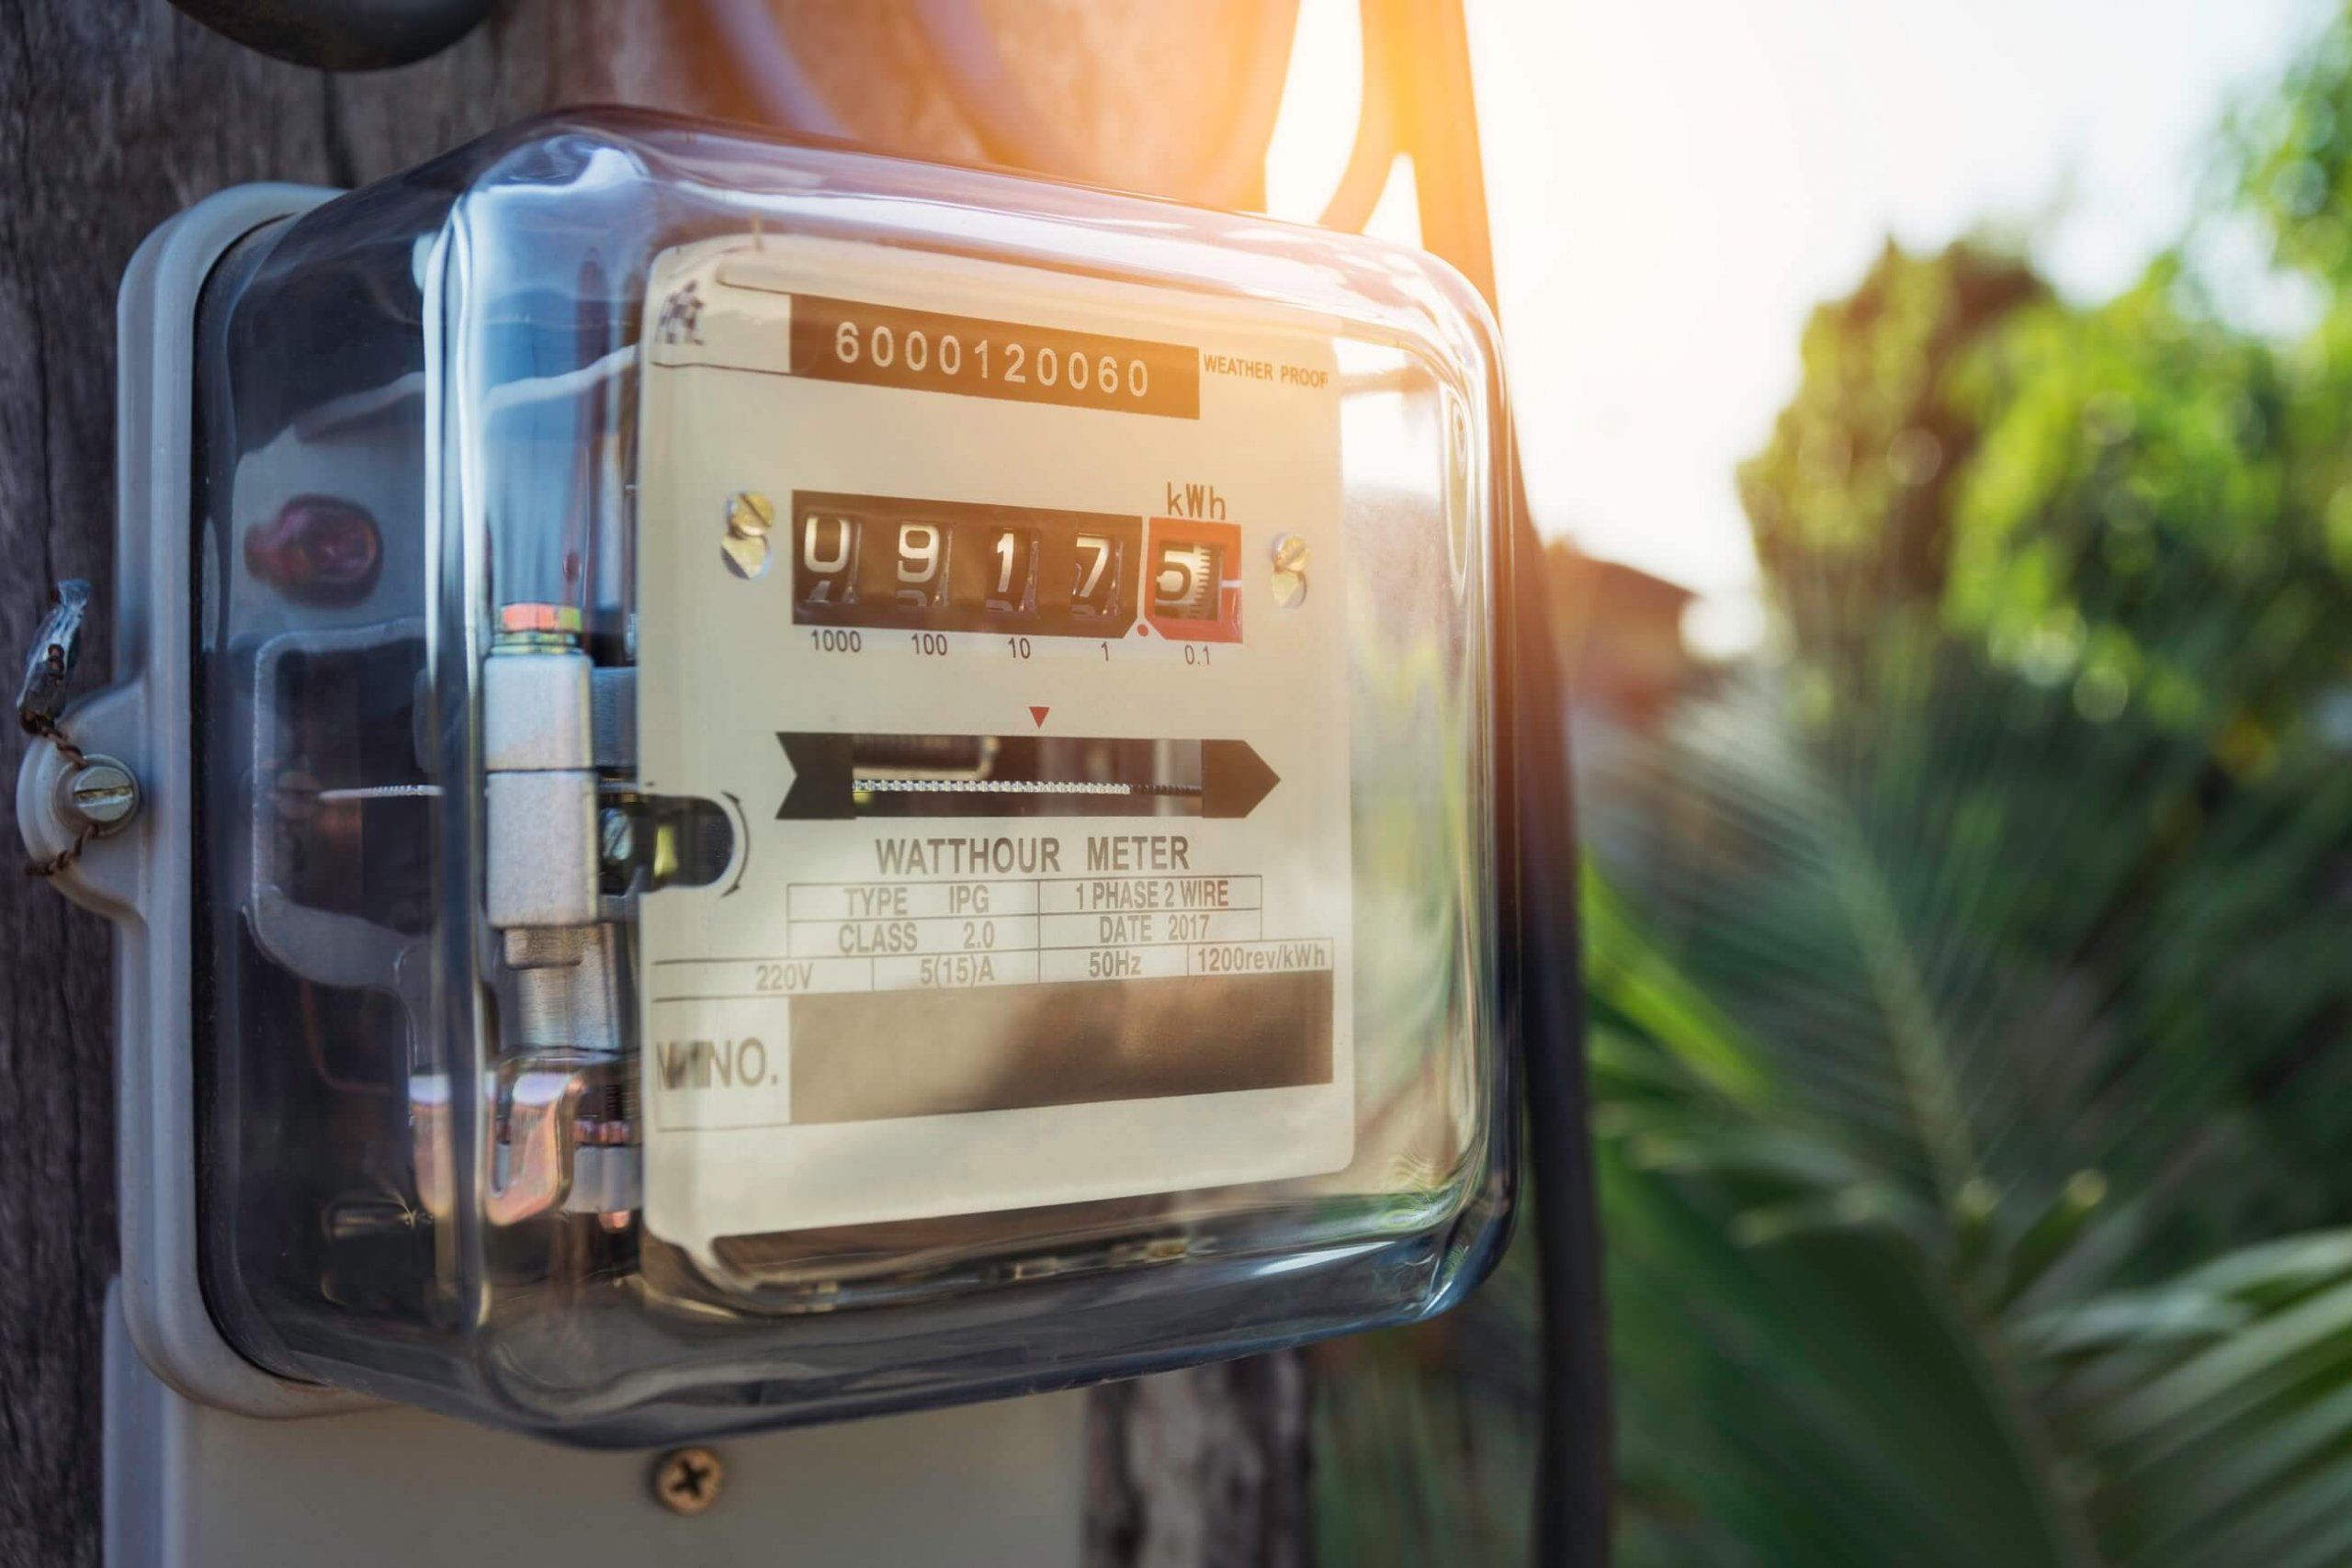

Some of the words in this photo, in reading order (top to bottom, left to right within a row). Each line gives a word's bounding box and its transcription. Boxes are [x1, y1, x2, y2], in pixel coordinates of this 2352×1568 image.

[835, 321, 1148, 398] 6000120060
[1204, 353, 1273, 382] WEATHER
[1280, 365, 1329, 389] PROOF
[1167, 481, 1226, 521] kWh
[810, 629, 862, 653] 1000
[910, 633, 948, 656] 100
[1008, 637, 1031, 660] 10
[1102, 641, 1109, 661] 1
[1184, 645, 1211, 665] 0.1
[875, 837, 1061, 874] WATTHOUR
[1087, 836, 1190, 871] METER
[843, 886, 909, 917] TYPE
[1076, 883, 1084, 910] 1
[1092, 882, 1159, 909] PHASE
[1164, 882, 1175, 908] 2
[1181, 879, 1229, 907] WIRE
[838, 921, 918, 953] CLASS
[963, 920, 995, 950] 2.0
[1099, 915, 1152, 944] DATE
[1168, 914, 1211, 941] 2017
[920, 954, 995, 989] 5(15)A
[1089, 950, 1142, 977] 50Hz
[1197, 943, 1326, 973] 1200rev/kWh
[755, 963, 814, 992] 220V
